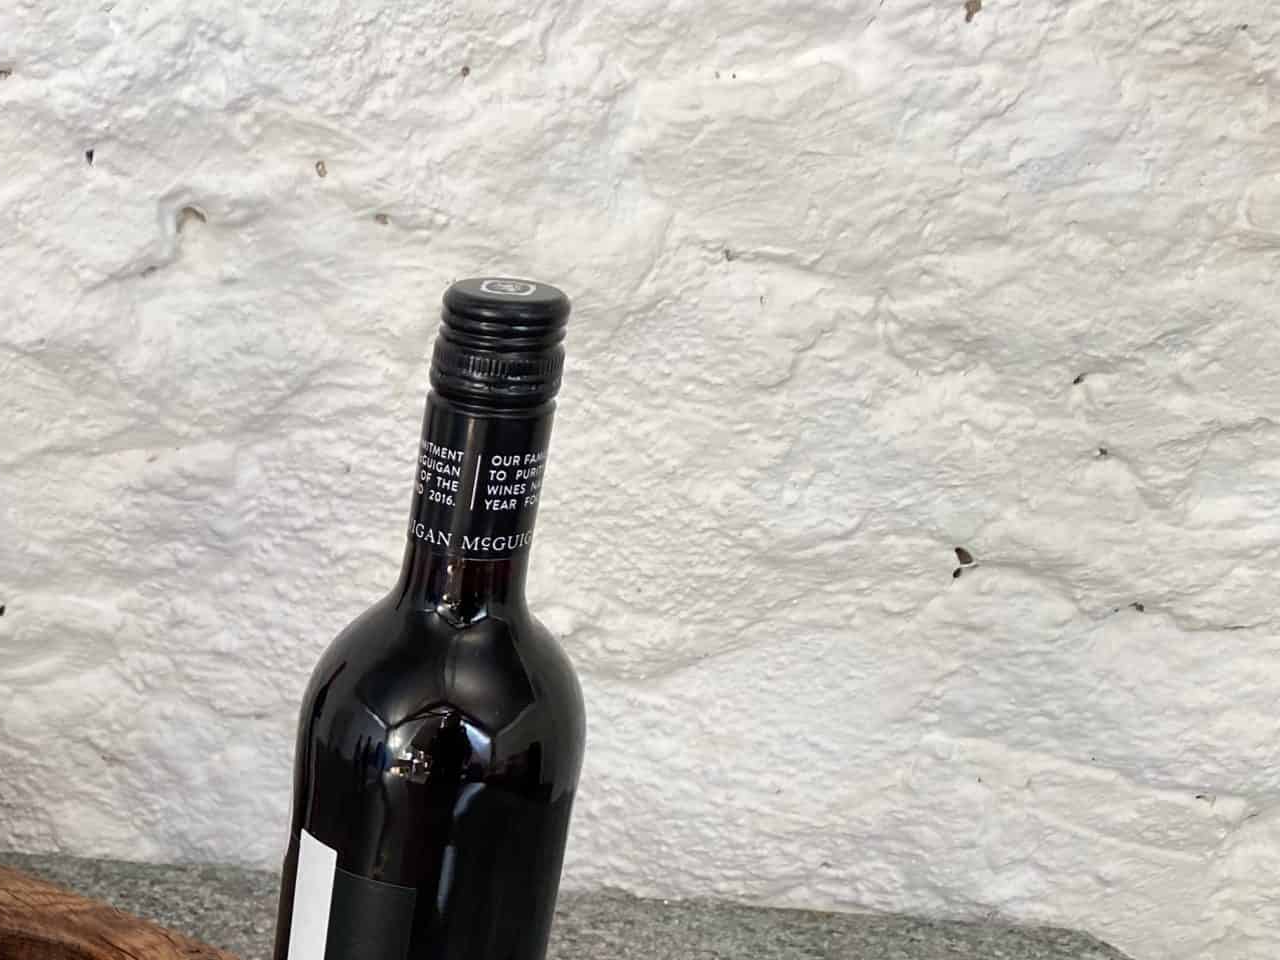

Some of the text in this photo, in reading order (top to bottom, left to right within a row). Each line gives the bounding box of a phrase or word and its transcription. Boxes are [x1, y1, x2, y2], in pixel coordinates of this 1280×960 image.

[491, 455, 521, 467] OUR
[420, 469, 460, 492] OF THE
[489, 469, 507, 481] TO
[486, 483, 527, 495] WINES
[428, 489, 456, 507] 2016.
[484, 499, 518, 511] YEAR
